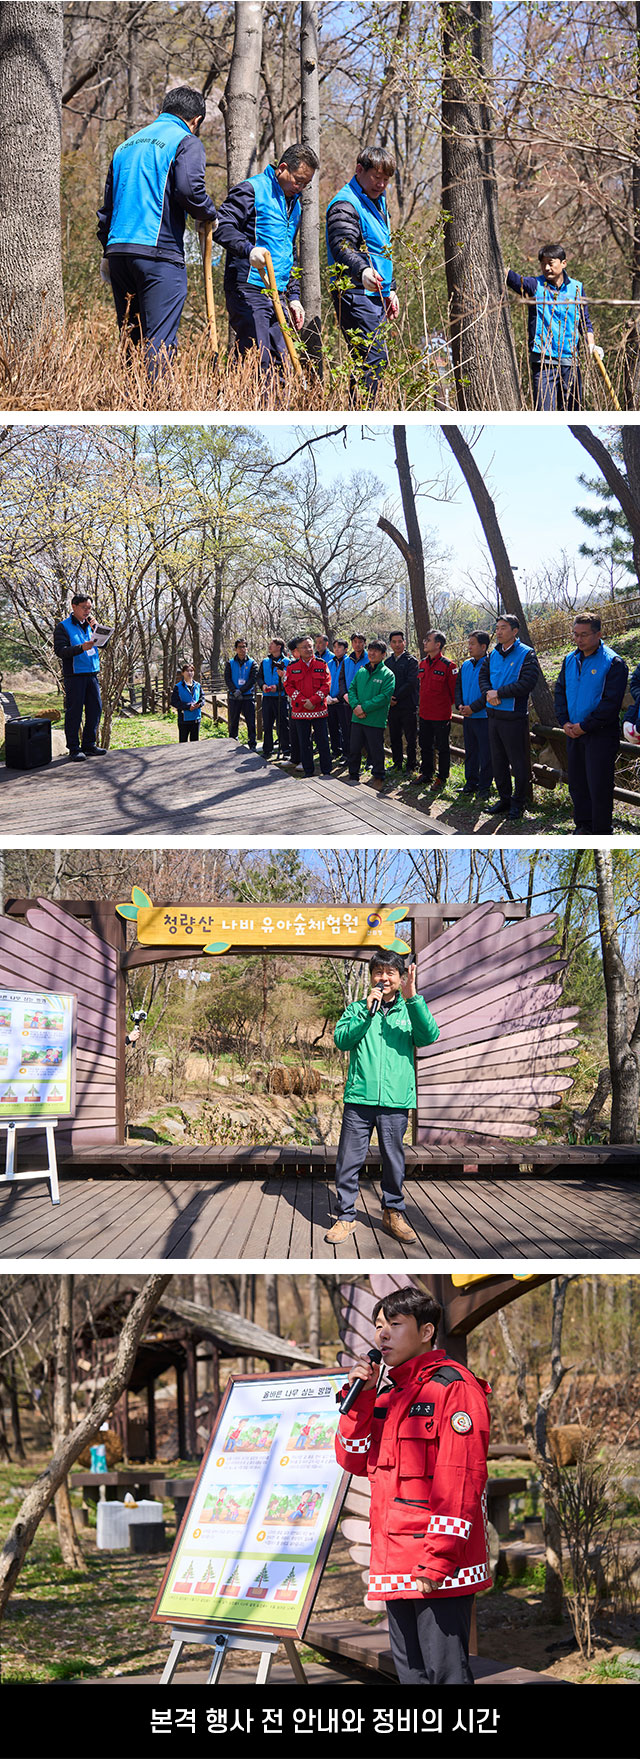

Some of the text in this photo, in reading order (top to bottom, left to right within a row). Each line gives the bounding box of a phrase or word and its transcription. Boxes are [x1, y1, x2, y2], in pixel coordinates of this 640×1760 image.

[163, 913, 359, 936] 청량산 나비 유아숲체험원
[285, 1388, 299, 1397] 나무
[301, 1387, 315, 1397] 심는
